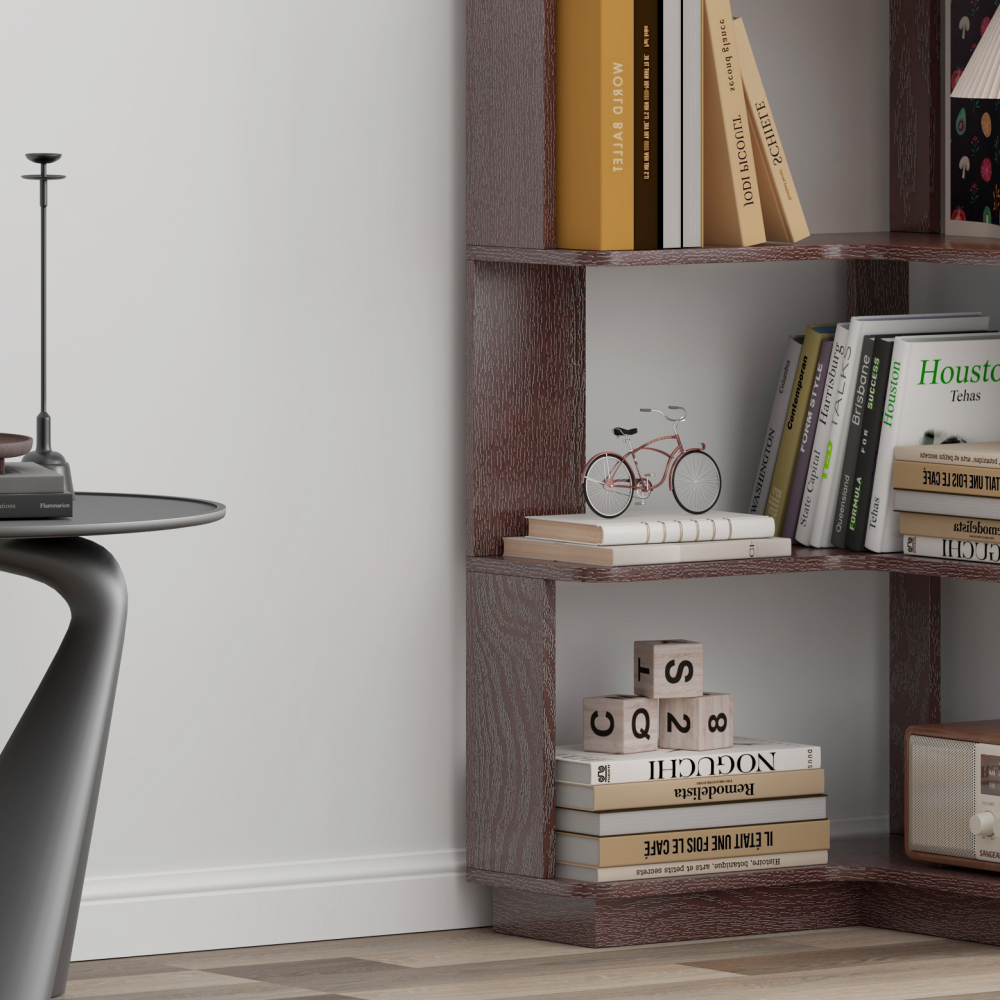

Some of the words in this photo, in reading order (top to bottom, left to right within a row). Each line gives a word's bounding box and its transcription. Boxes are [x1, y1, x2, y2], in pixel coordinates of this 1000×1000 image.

[779, 360, 790, 394] Columbia
[819, 342, 844, 425] Harrisburg
[787, 356, 808, 430] Contemporan
[852, 355, 870, 426] Brisbane
[884, 361, 901, 427] Houston
[950, 389, 981, 402] Tehas
[800, 411, 812, 452] FORM
[810, 363, 823, 408] STYLE
[821, 440, 833, 482] TED
[832, 346, 851, 425] TALKS
[849, 477, 862, 531] FORMULA
[867, 357, 880, 410] SUCCESS
[751, 428, 775, 512] WASHINGTON
[800, 496, 811, 527] State
[807, 450, 820, 492] Capital
[836, 474, 850, 532] Queensland
[869, 497, 879, 529] Tehas
[638, 657, 649, 681] T
[665, 659, 693, 684] S
[590, 710, 614, 737] C
[632, 708, 650, 740] Q
[667, 712, 691, 734] 2
[708, 712, 727, 733] 8
[648, 752, 776, 780] NOGUCHI
[674, 783, 755, 800] Remodelista
[644, 839, 669, 860] CAFÉ
[672, 839, 684, 854] LE
[687, 836, 709, 853] FOIS
[712, 835, 731, 851] UNE
[734, 832, 761, 850] ÉTAIT
[764, 831, 773, 846] IL
[636, 866, 662, 875] secrets
[664, 865, 685, 874] petits
[686, 864, 694, 872] et
[712, 861, 748, 869] botanique,
[750, 858, 780, 866] Histoire,
